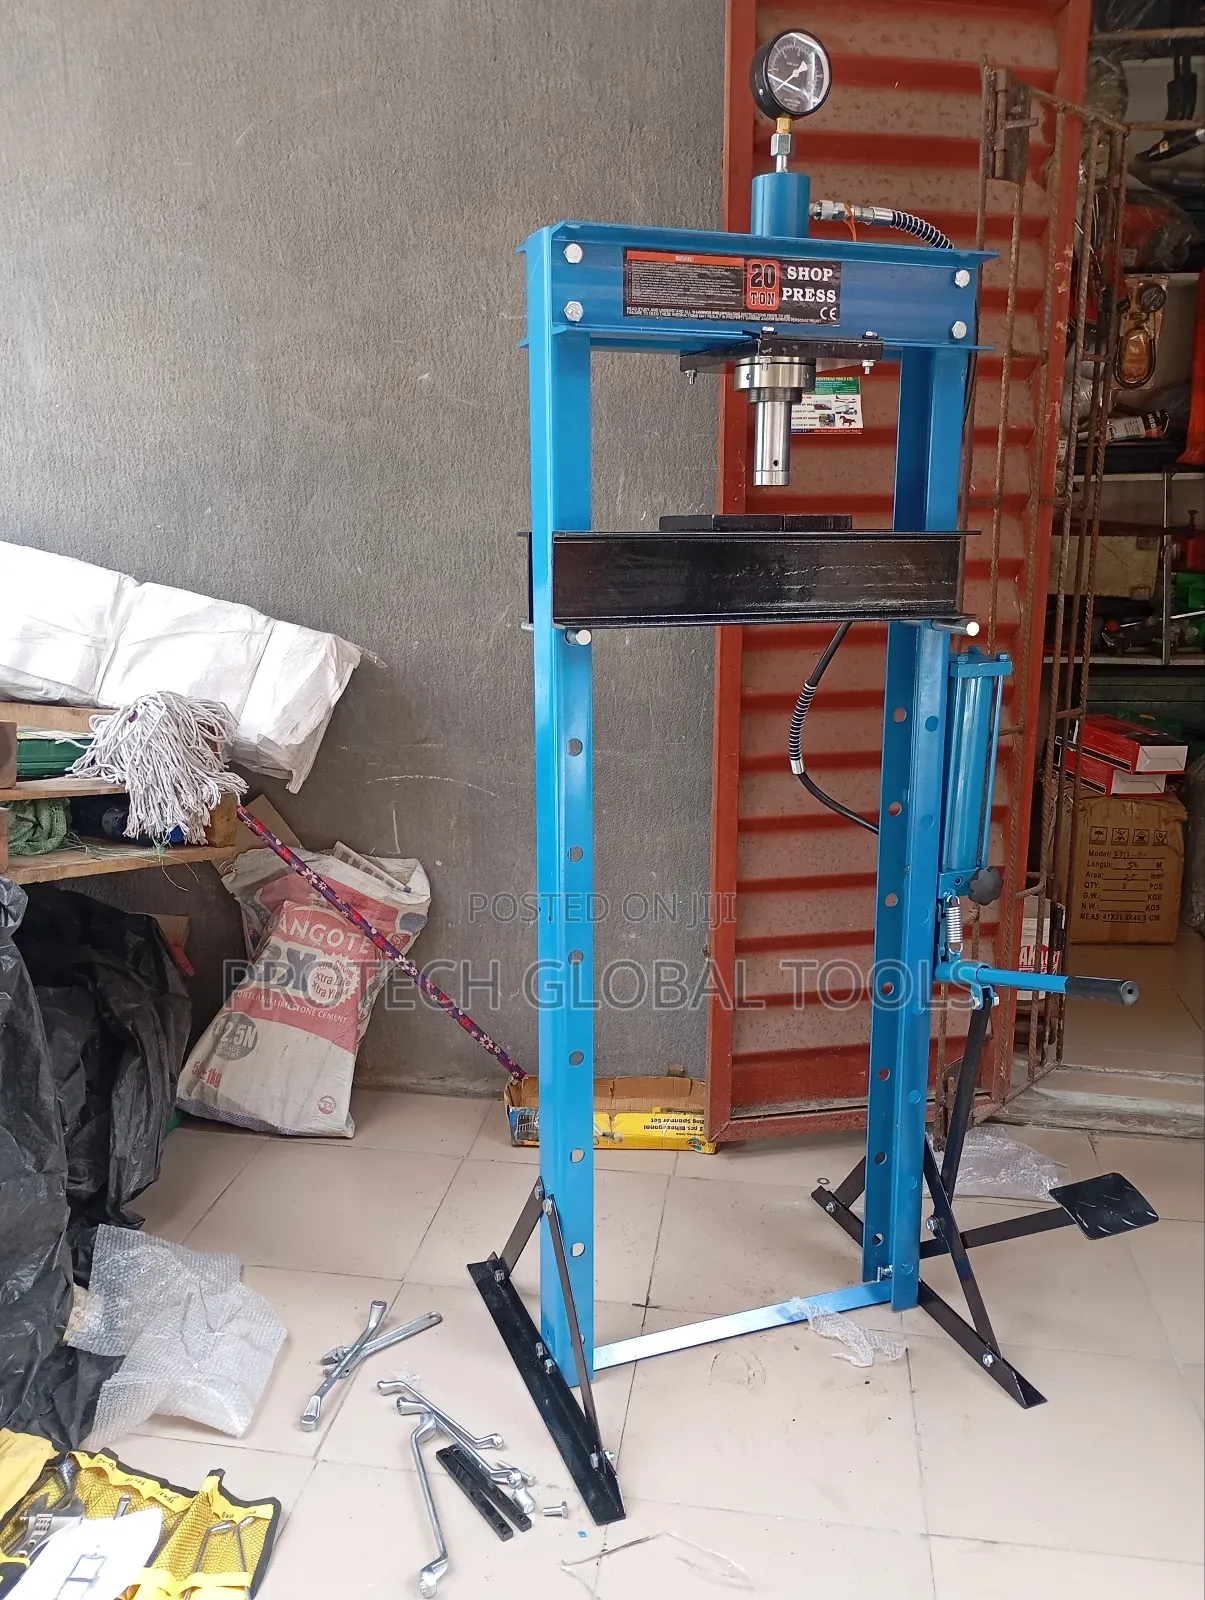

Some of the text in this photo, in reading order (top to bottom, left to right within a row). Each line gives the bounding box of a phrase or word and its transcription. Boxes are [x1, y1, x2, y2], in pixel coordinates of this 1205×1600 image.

[750, 263, 777, 289] 20
[787, 266, 833, 282] SHOP
[750, 291, 776, 307] TON
[781, 287, 837, 303] PRESS
[1088, 849, 1112, 857] Model:
[1087, 860, 1112, 869] Length:
[274, 912, 371, 955] ANGOTE
[327, 987, 349, 1000] Yield
[273, 998, 316, 1017] LIMESTONE
[317, 1009, 347, 1024] CEMENT
